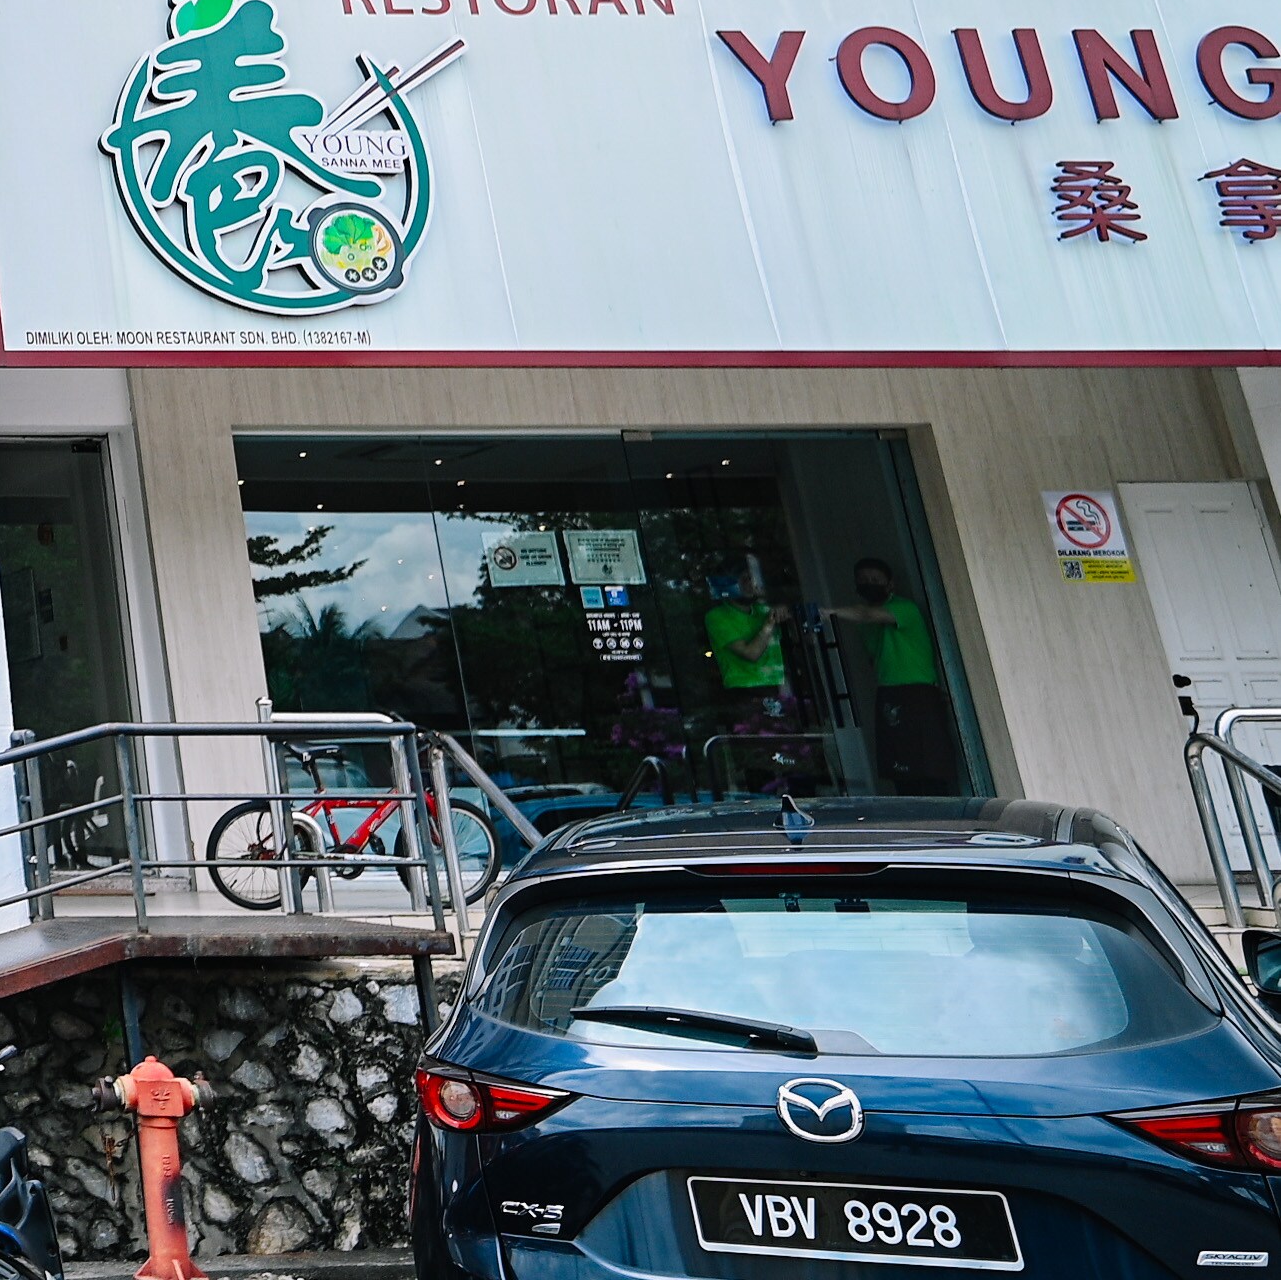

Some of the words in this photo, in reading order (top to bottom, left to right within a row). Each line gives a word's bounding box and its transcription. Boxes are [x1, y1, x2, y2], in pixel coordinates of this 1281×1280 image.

[715, 26, 1281, 124] YOUNG
[302, 133, 406, 157] YOUNG
[321, 157, 368, 168] SANNA
[372, 158, 401, 169] MEE
[1049, 158, 1281, 244] 桑拿
[26, 331, 73, 345] DIMILIKI
[77, 331, 113, 345] OLEH:
[116, 331, 153, 345] MOON
[157, 331, 236, 345] RESTAURANT
[239, 331, 268, 345] SDN.
[271, 331, 300, 345] BHD.
[587, 619, 610, 631] 11AM
[620, 619, 643, 631] 11PM
[500, 1201, 564, 1219] CX-5
[738, 1193, 816, 1240] VBV
[843, 1200, 962, 1249] 8928
